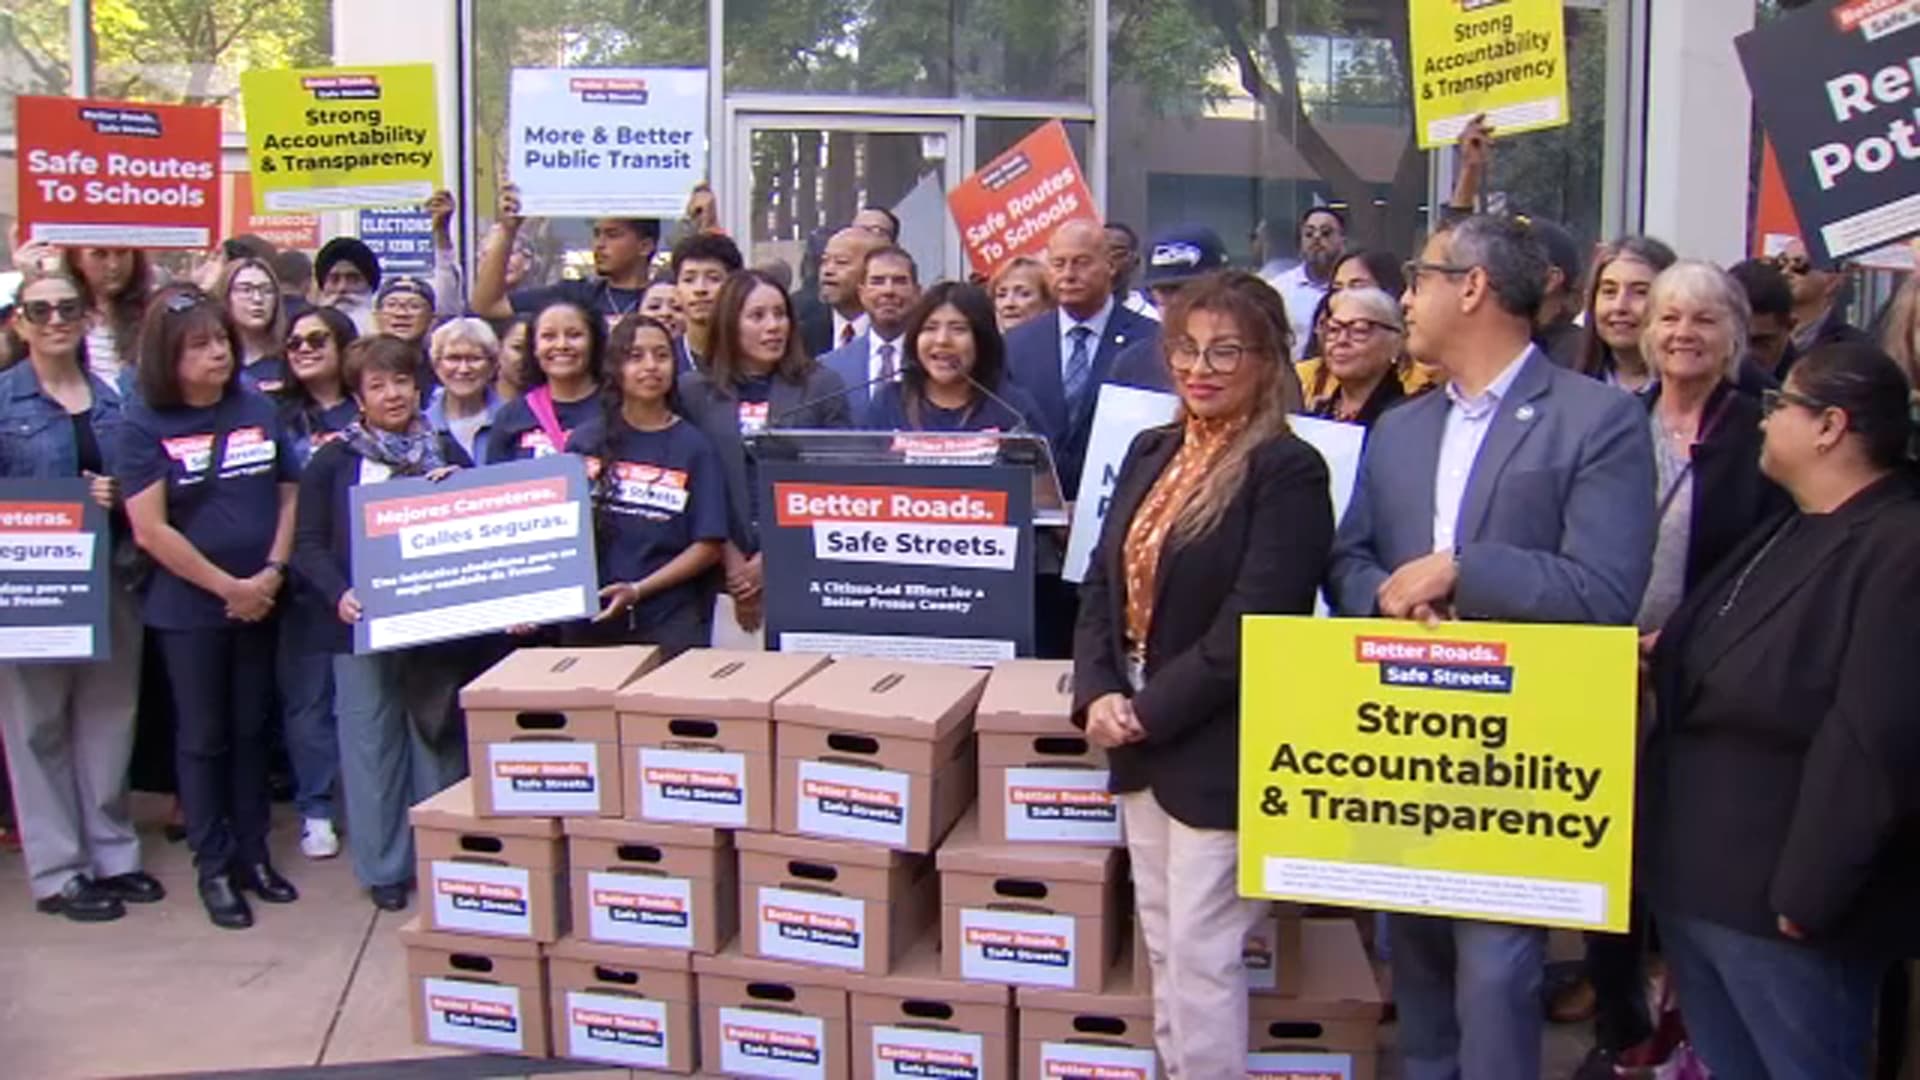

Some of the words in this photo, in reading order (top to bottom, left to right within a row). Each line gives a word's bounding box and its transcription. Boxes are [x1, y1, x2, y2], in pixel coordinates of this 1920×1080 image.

[1455, 15, 1513, 42] Strong
[1424, 30, 1551, 75] Accountability
[1422, 83, 1434, 99] &
[1438, 57, 1556, 96] Transparency
[305, 110, 381, 126] Strong
[263, 125, 427, 150] Accountability
[525, 127, 585, 145] More
[592, 126, 607, 145] &
[617, 126, 692, 145] Better
[1810, 107, 1920, 190] Pot
[28, 149, 98, 175] Safe
[107, 153, 214, 180] Routes
[260, 156, 277, 173] &
[282, 150, 433, 172] Transparency
[525, 149, 600, 168] Public
[608, 149, 691, 169] Transit
[37, 179, 76, 202] To
[85, 181, 205, 208] Schools
[966, 213, 1006, 248] Safe
[1007, 166, 1075, 219] Routes
[362, 217, 432, 233] ELECTIONS
[978, 242, 1003, 264] To
[1004, 194, 1078, 250] Schools
[376, 503, 451, 526] Mejores
[455, 487, 558, 514] Carreteras.
[787, 493, 882, 516] Better
[892, 494, 995, 519] Roads.
[0, 511, 73, 528] eteras.
[411, 526, 473, 550] Calles
[479, 514, 569, 538] Seguras.
[0, 545, 83, 562] eguras.
[827, 531, 888, 553] Safe
[896, 534, 1005, 556] Streets.
[809, 582, 821, 593] A
[1361, 641, 1427, 659] Better
[1430, 644, 1499, 661] Roads.
[1387, 666, 1429, 682] Safe
[1433, 668, 1507, 686] Streets.
[1357, 701, 1508, 748] Strong
[1270, 743, 1602, 801] Accountability
[1261, 786, 1289, 816] &
[1302, 789, 1611, 849] Transparency
